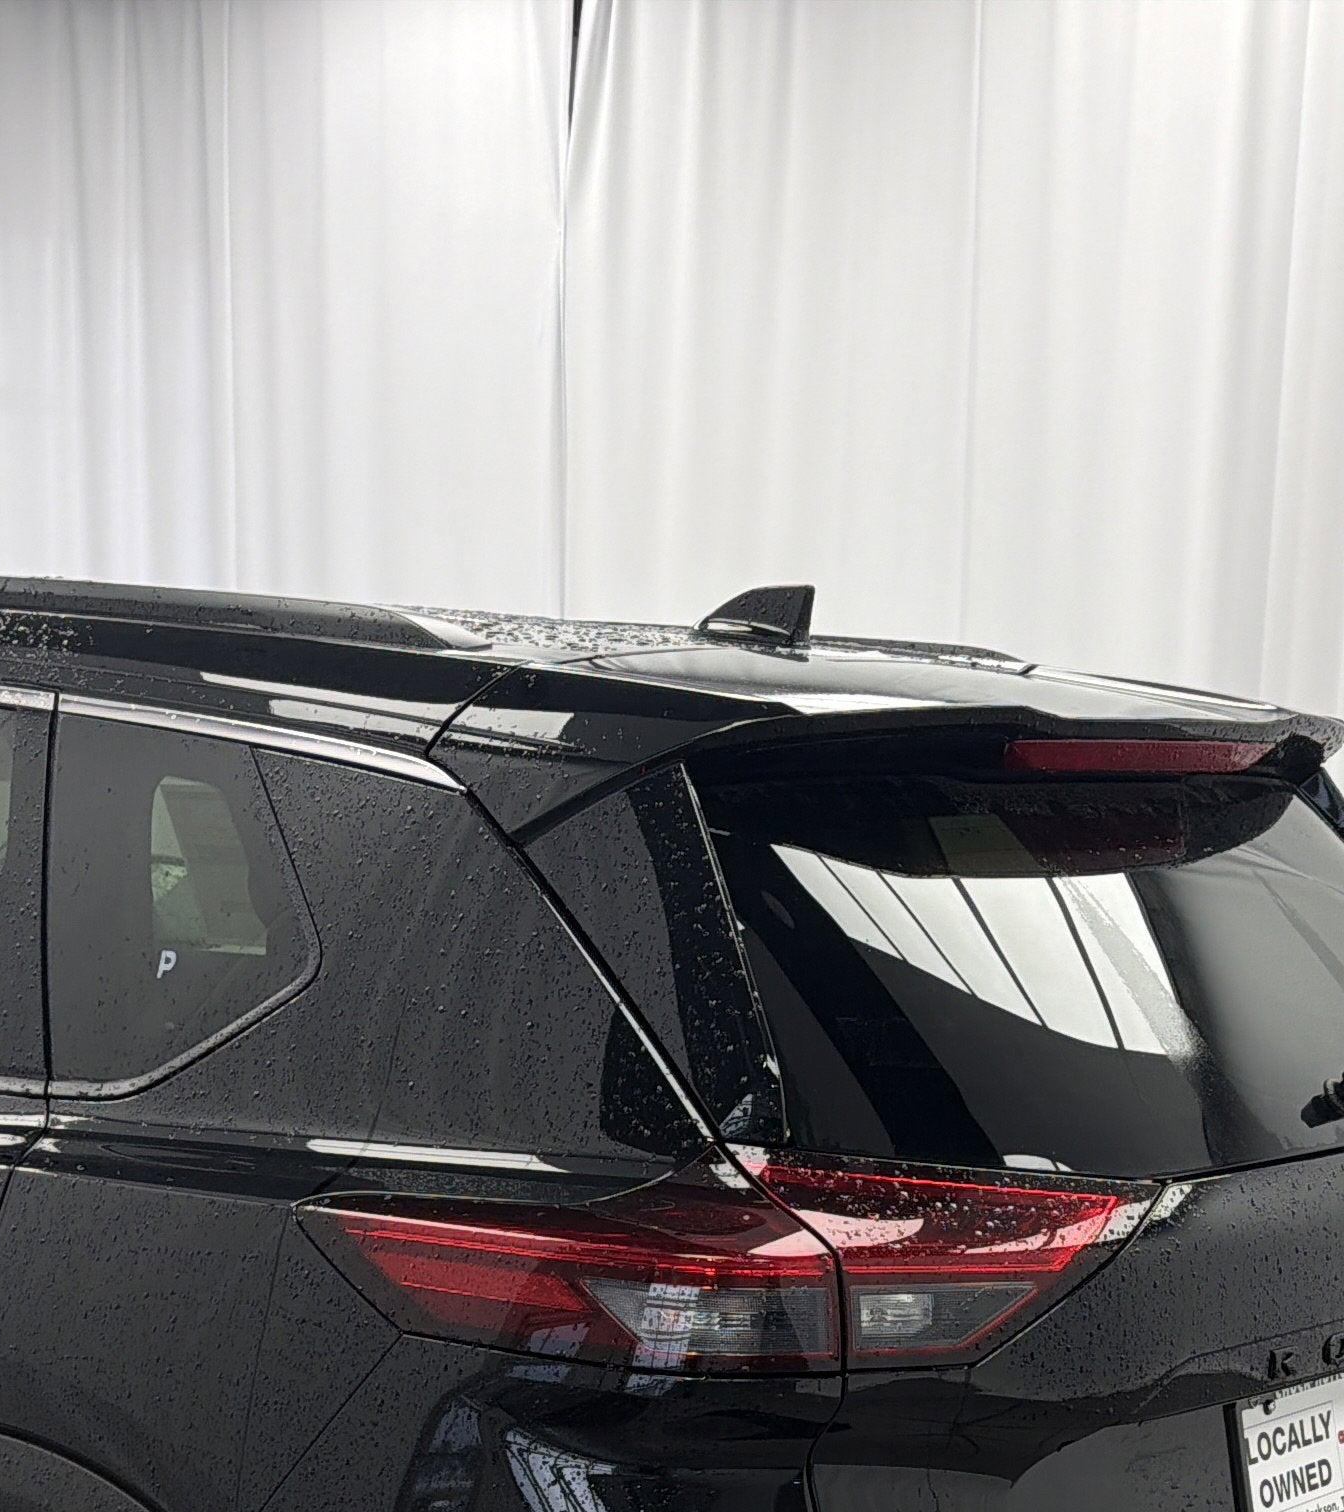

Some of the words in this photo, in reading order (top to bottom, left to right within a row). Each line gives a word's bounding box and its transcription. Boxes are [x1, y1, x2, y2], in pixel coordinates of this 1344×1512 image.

[157, 950, 177, 979] P
[1245, 1409, 1332, 1465] LOCALLY
[1259, 1458, 1333, 1508] OWNED
